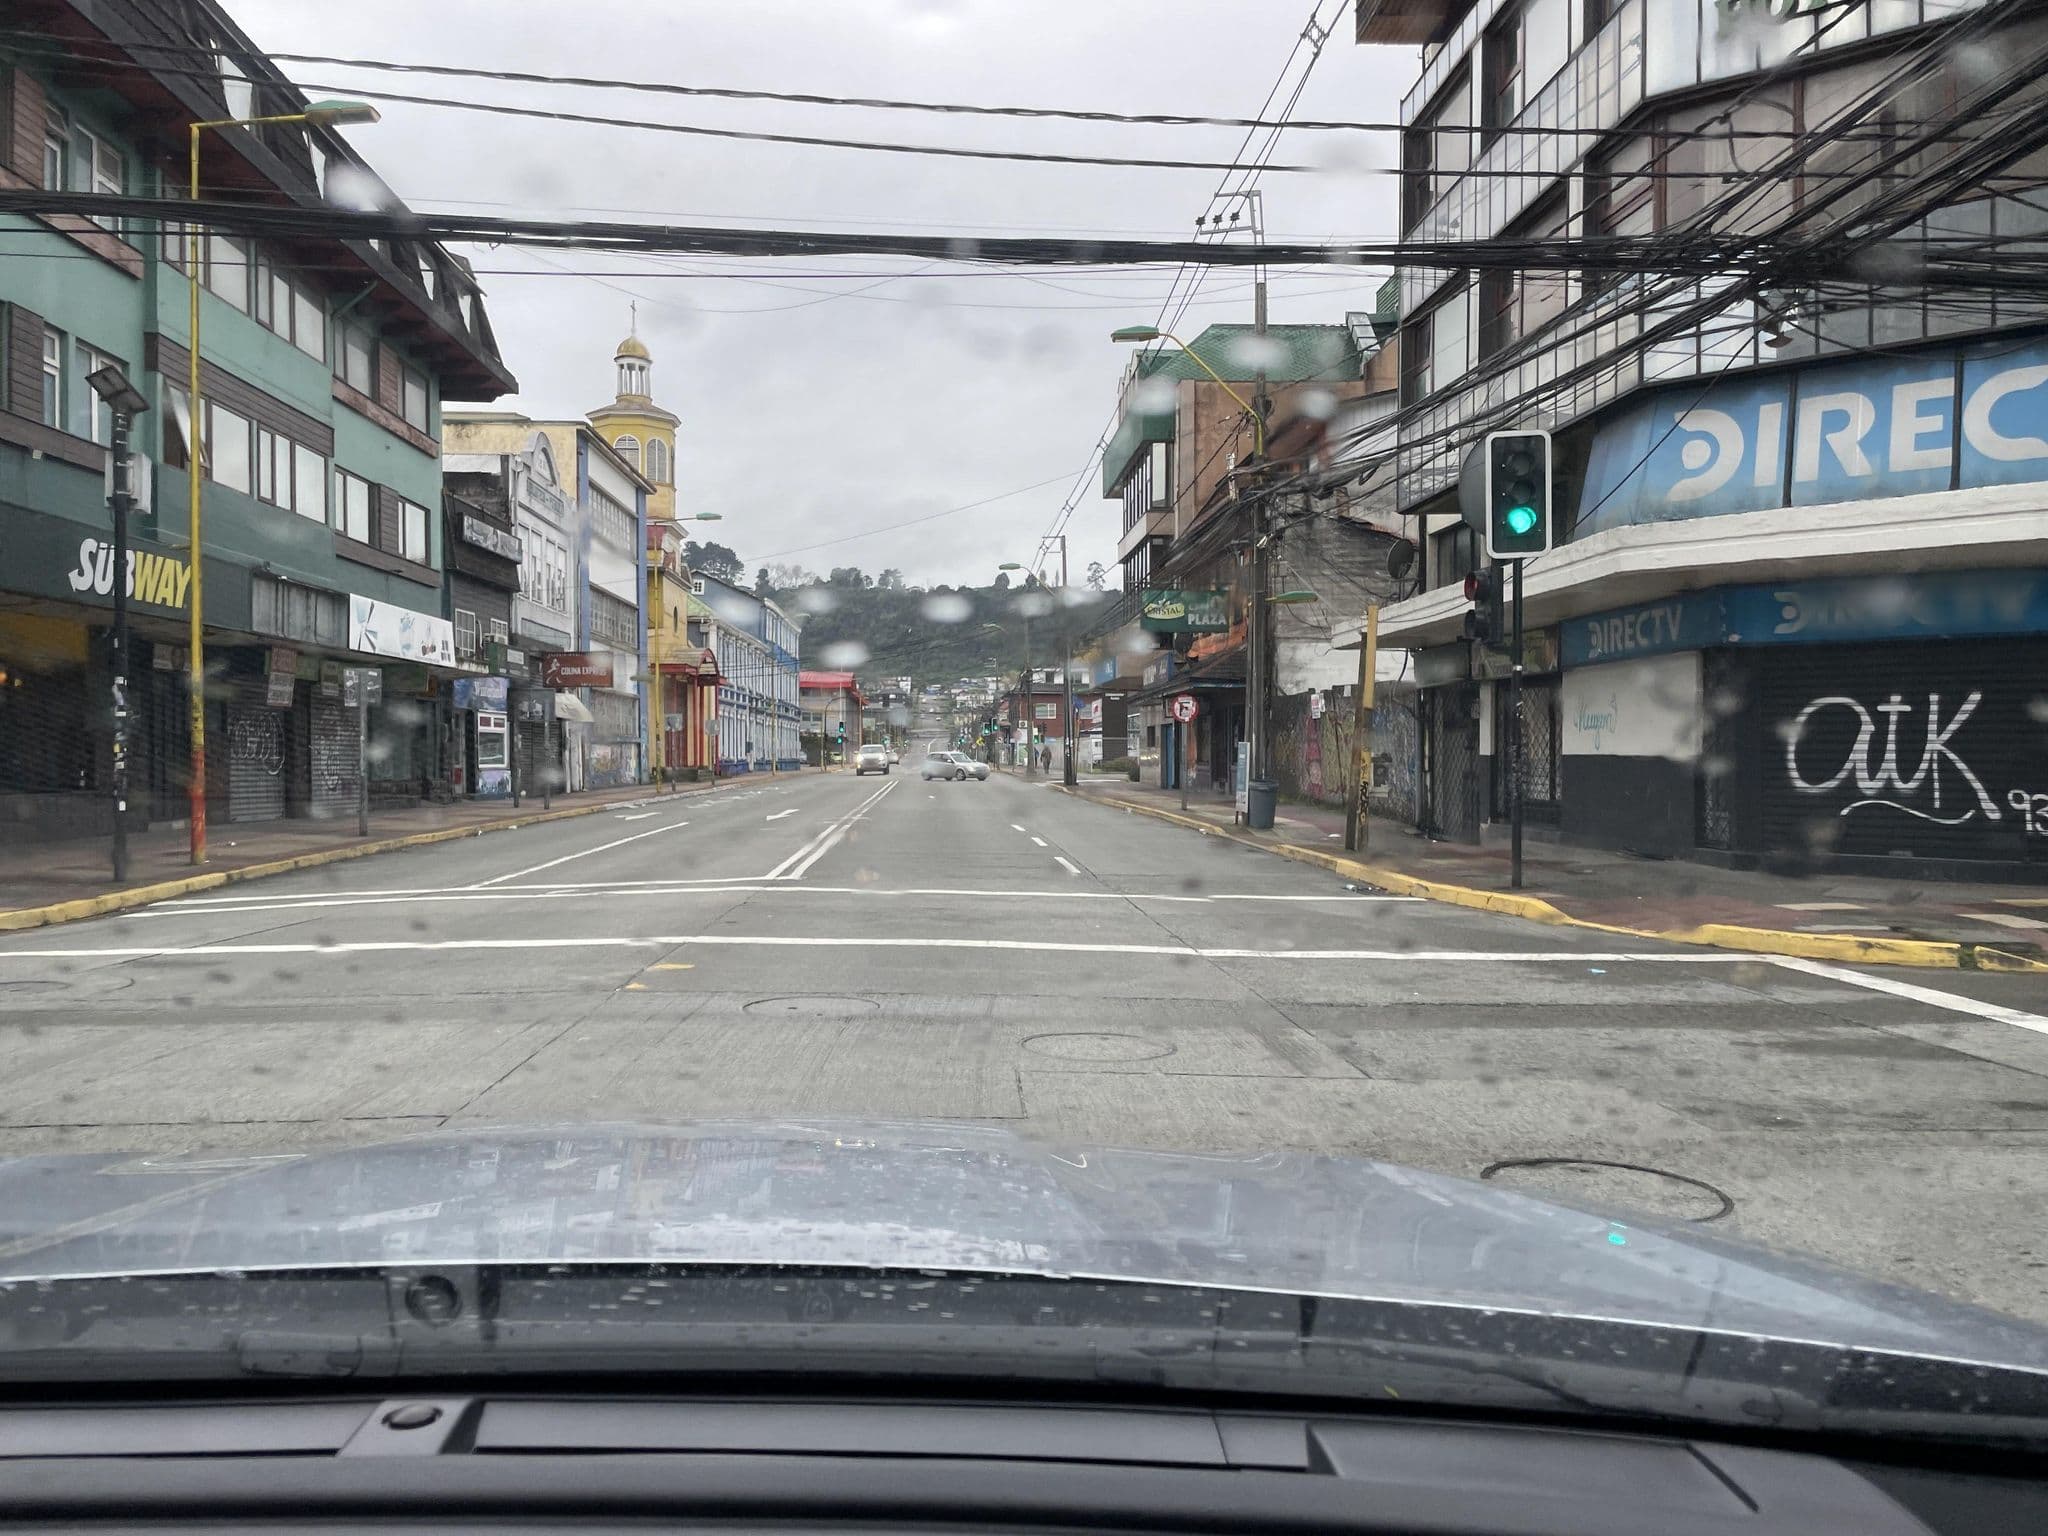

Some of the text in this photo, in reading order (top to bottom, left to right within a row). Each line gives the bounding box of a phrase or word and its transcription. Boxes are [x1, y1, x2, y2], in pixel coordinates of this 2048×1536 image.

[1666, 364, 2048, 501] DIREC
[1187, 613, 1226, 625] PLAZA
[1588, 604, 1682, 659] DIRECTV
[582, 667, 607, 675] EXPR
